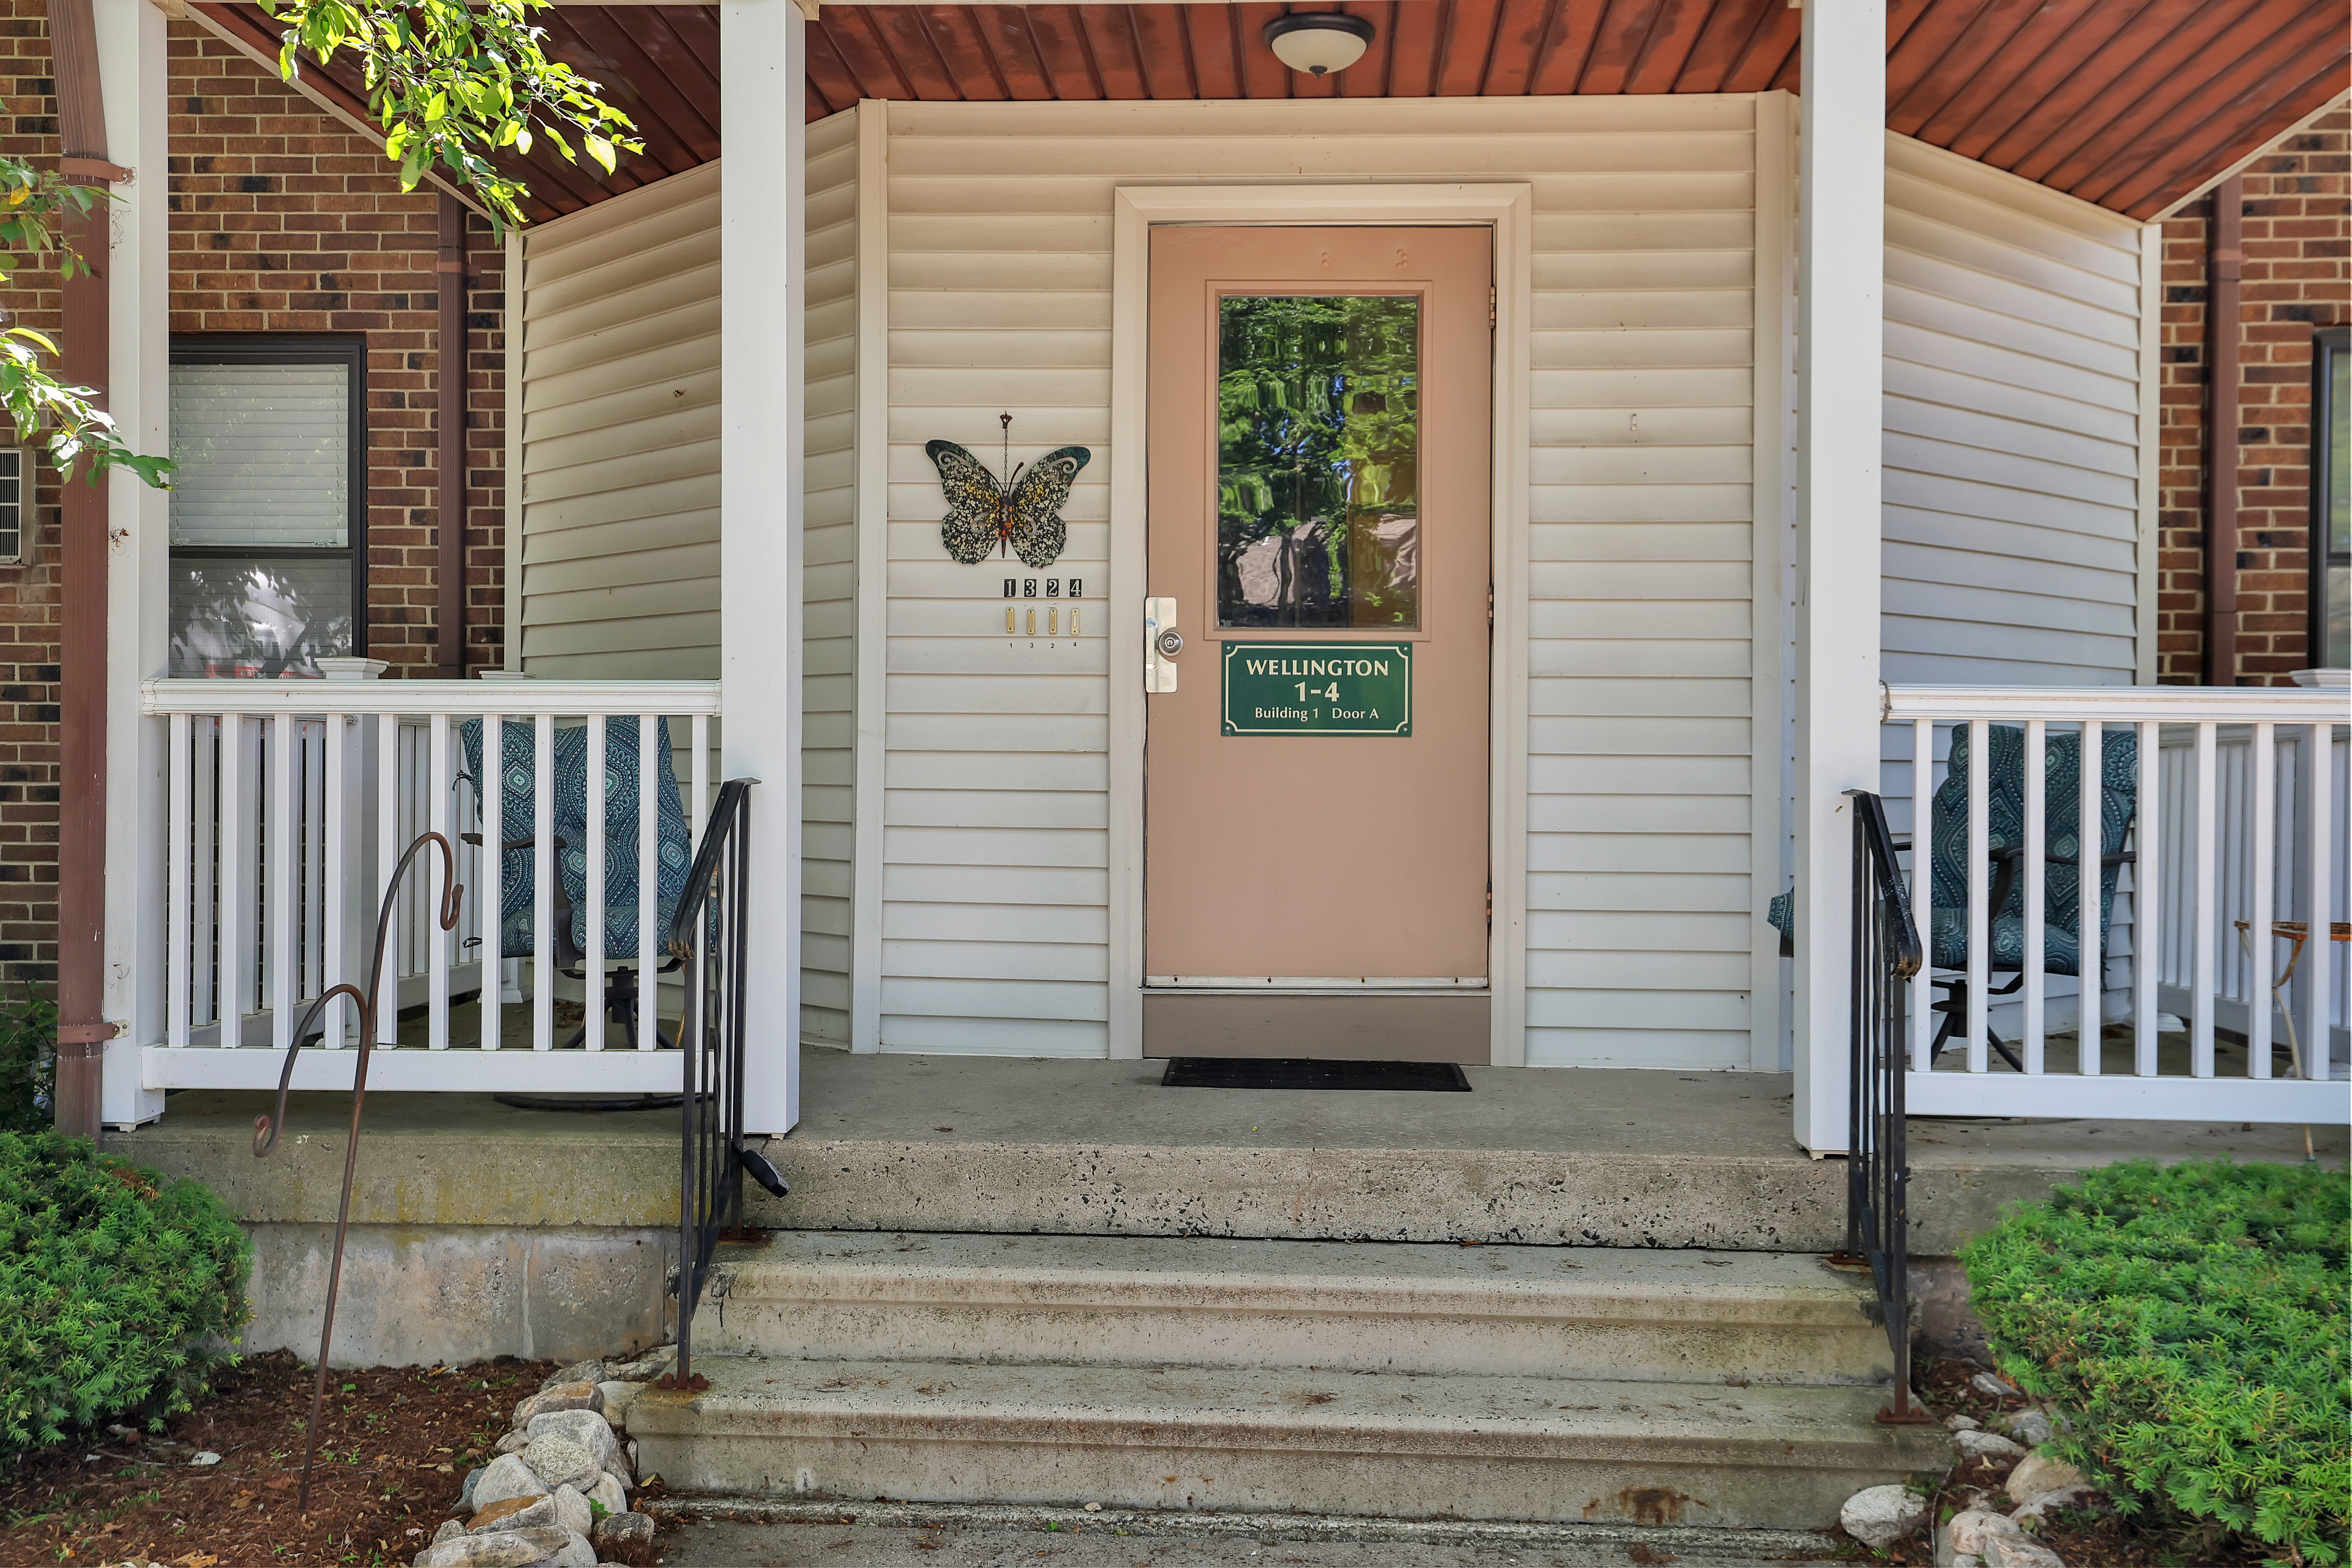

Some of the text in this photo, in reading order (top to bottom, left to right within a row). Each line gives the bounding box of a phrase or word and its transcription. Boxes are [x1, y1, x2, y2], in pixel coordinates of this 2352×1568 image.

[1007, 580, 1081, 597] 1 3 2 4
[1246, 659, 1388, 676] WELLINGTON
[1294, 681, 1339, 702] 1-4
[1255, 707, 1379, 722] Building 1 Door A
